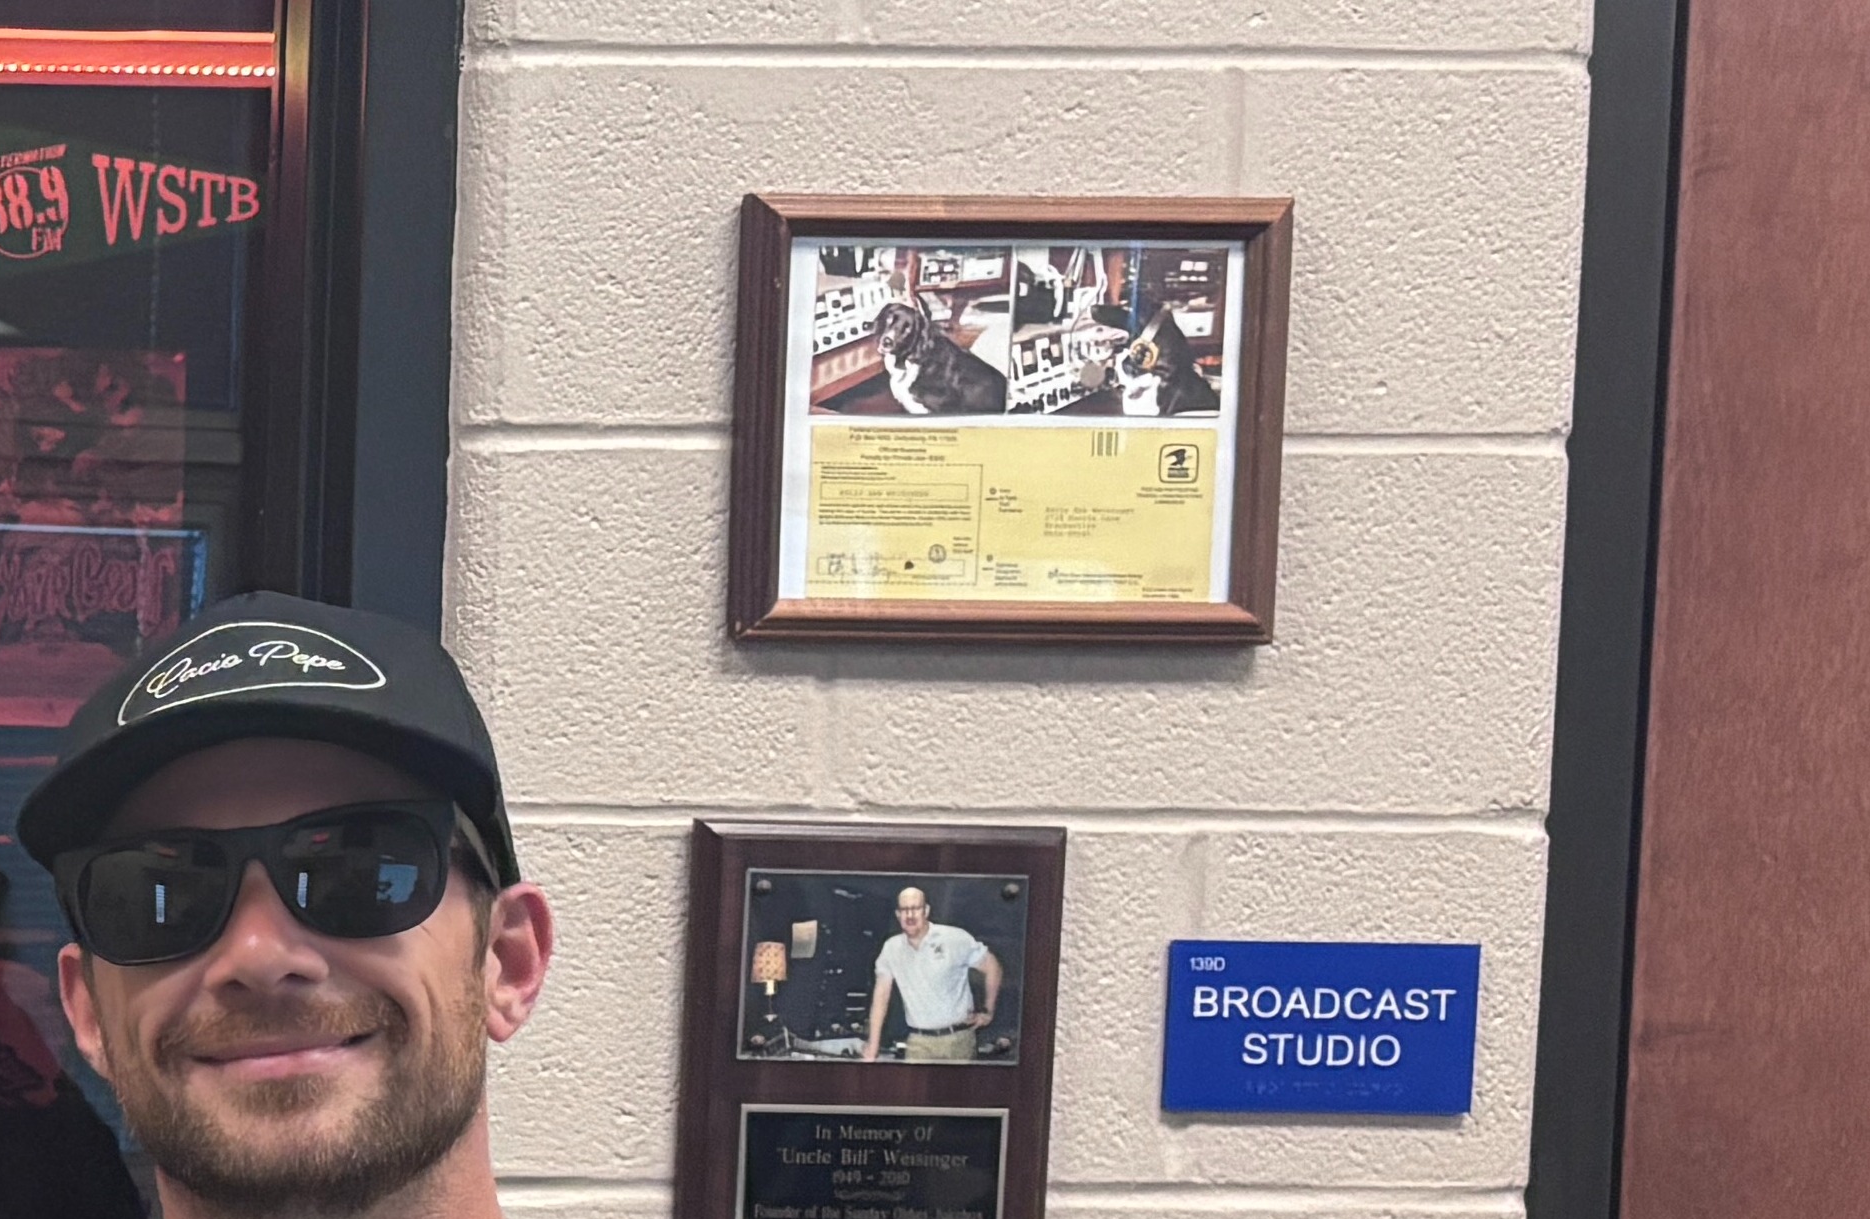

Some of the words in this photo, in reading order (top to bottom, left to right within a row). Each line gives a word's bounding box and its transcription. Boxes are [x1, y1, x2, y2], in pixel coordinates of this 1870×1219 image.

[91, 152, 260, 246] WSTB
[249, 640, 346, 674] Pepe
[1192, 985, 1458, 1022] BROADCAST
[1241, 1032, 1402, 1068] STUDIO
[815, 1124, 832, 1140] In
[839, 1124, 906, 1144] Memory
